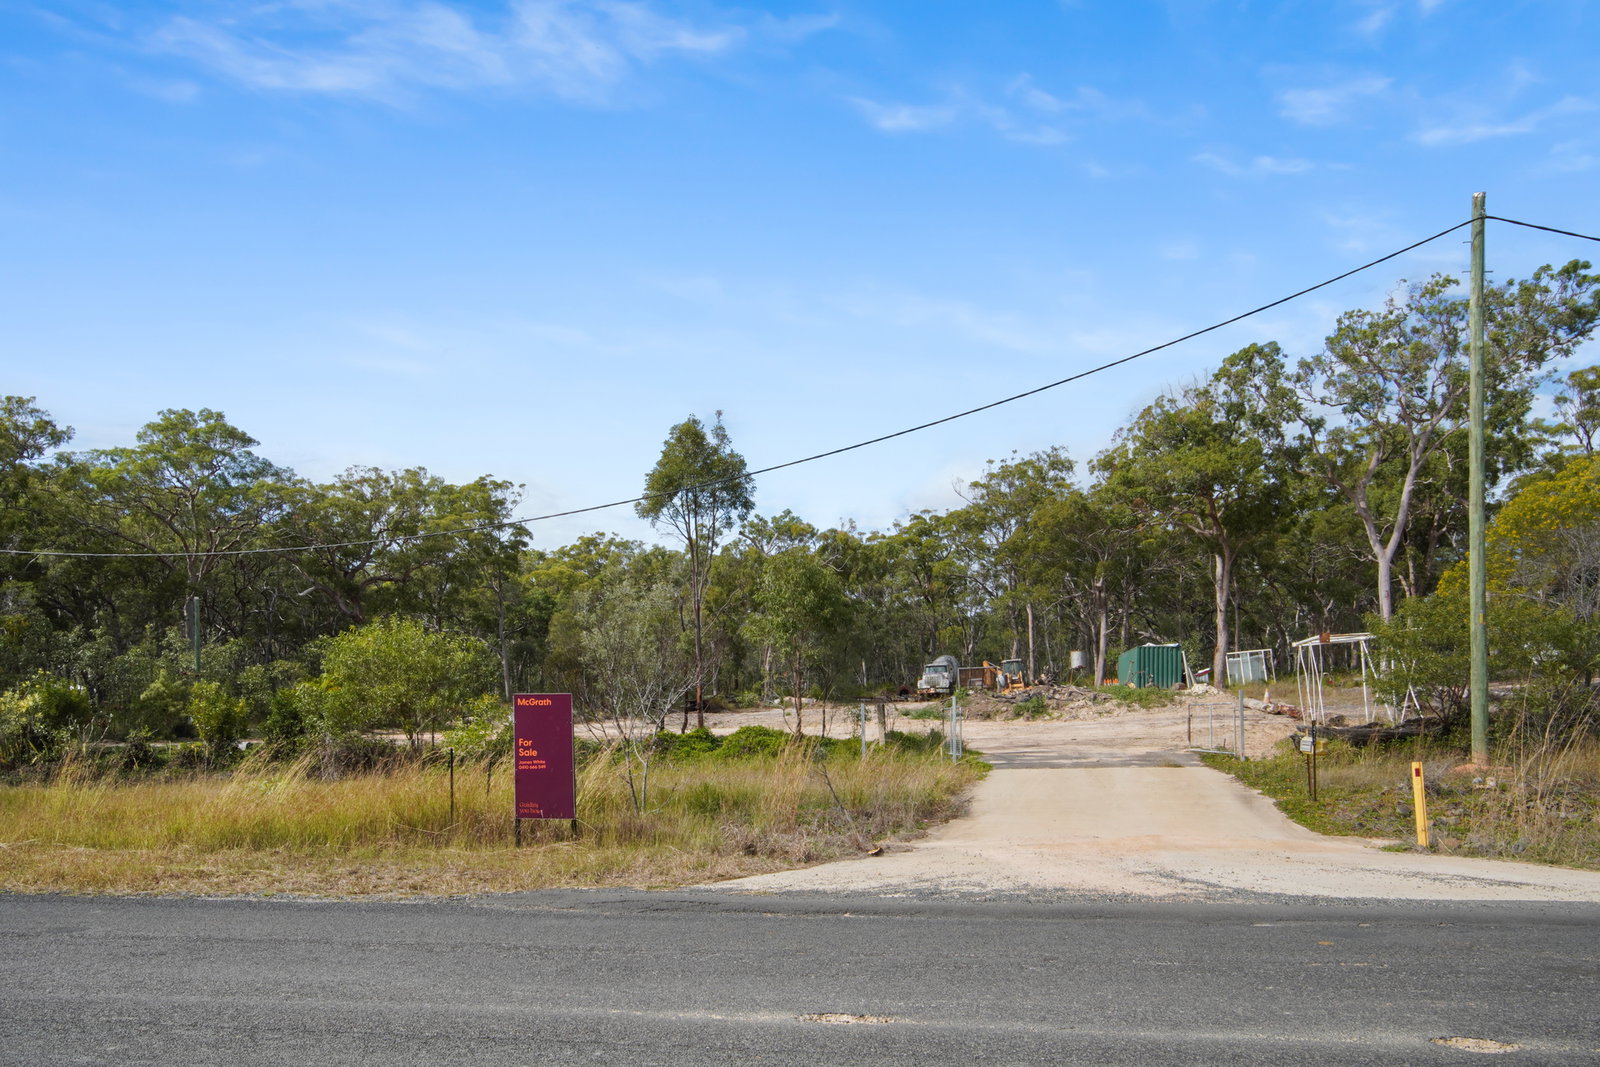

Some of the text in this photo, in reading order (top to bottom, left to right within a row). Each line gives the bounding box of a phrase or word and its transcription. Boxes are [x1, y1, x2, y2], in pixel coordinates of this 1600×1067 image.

[517, 698, 552, 706] McGrath
[518, 738, 533, 746] For
[518, 748, 538, 757] Sale
